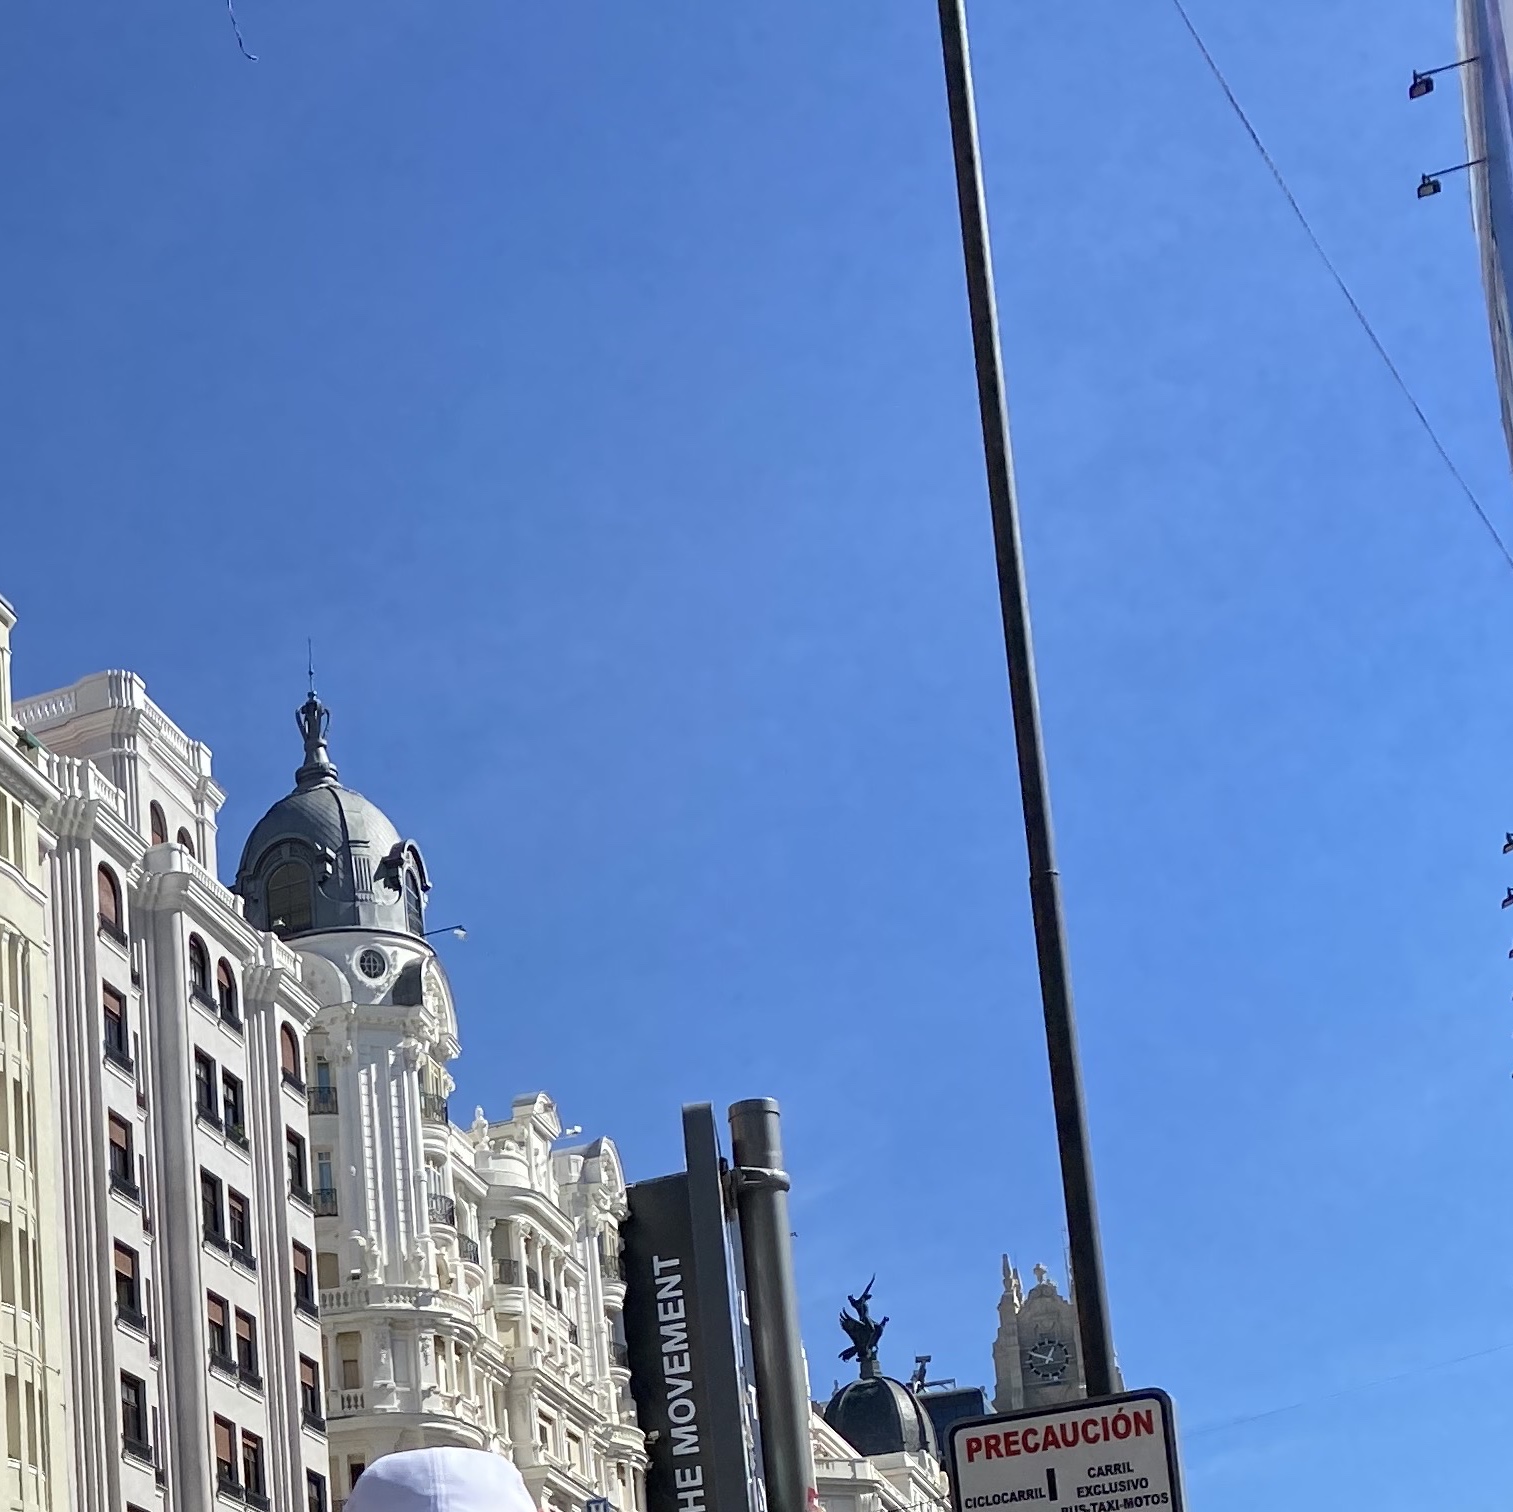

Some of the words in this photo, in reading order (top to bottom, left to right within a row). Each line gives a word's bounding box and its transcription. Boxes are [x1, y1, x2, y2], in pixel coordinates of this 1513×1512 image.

[652, 1255, 700, 1456] MOVEMENT
[966, 1407, 1154, 1463] PRECAUCIÓN
[1088, 1461, 1134, 1478] CARRIL
[965, 1487, 1046, 1509] CICLOCARRIL
[1077, 1477, 1149, 1498] EXCLUSIVO
